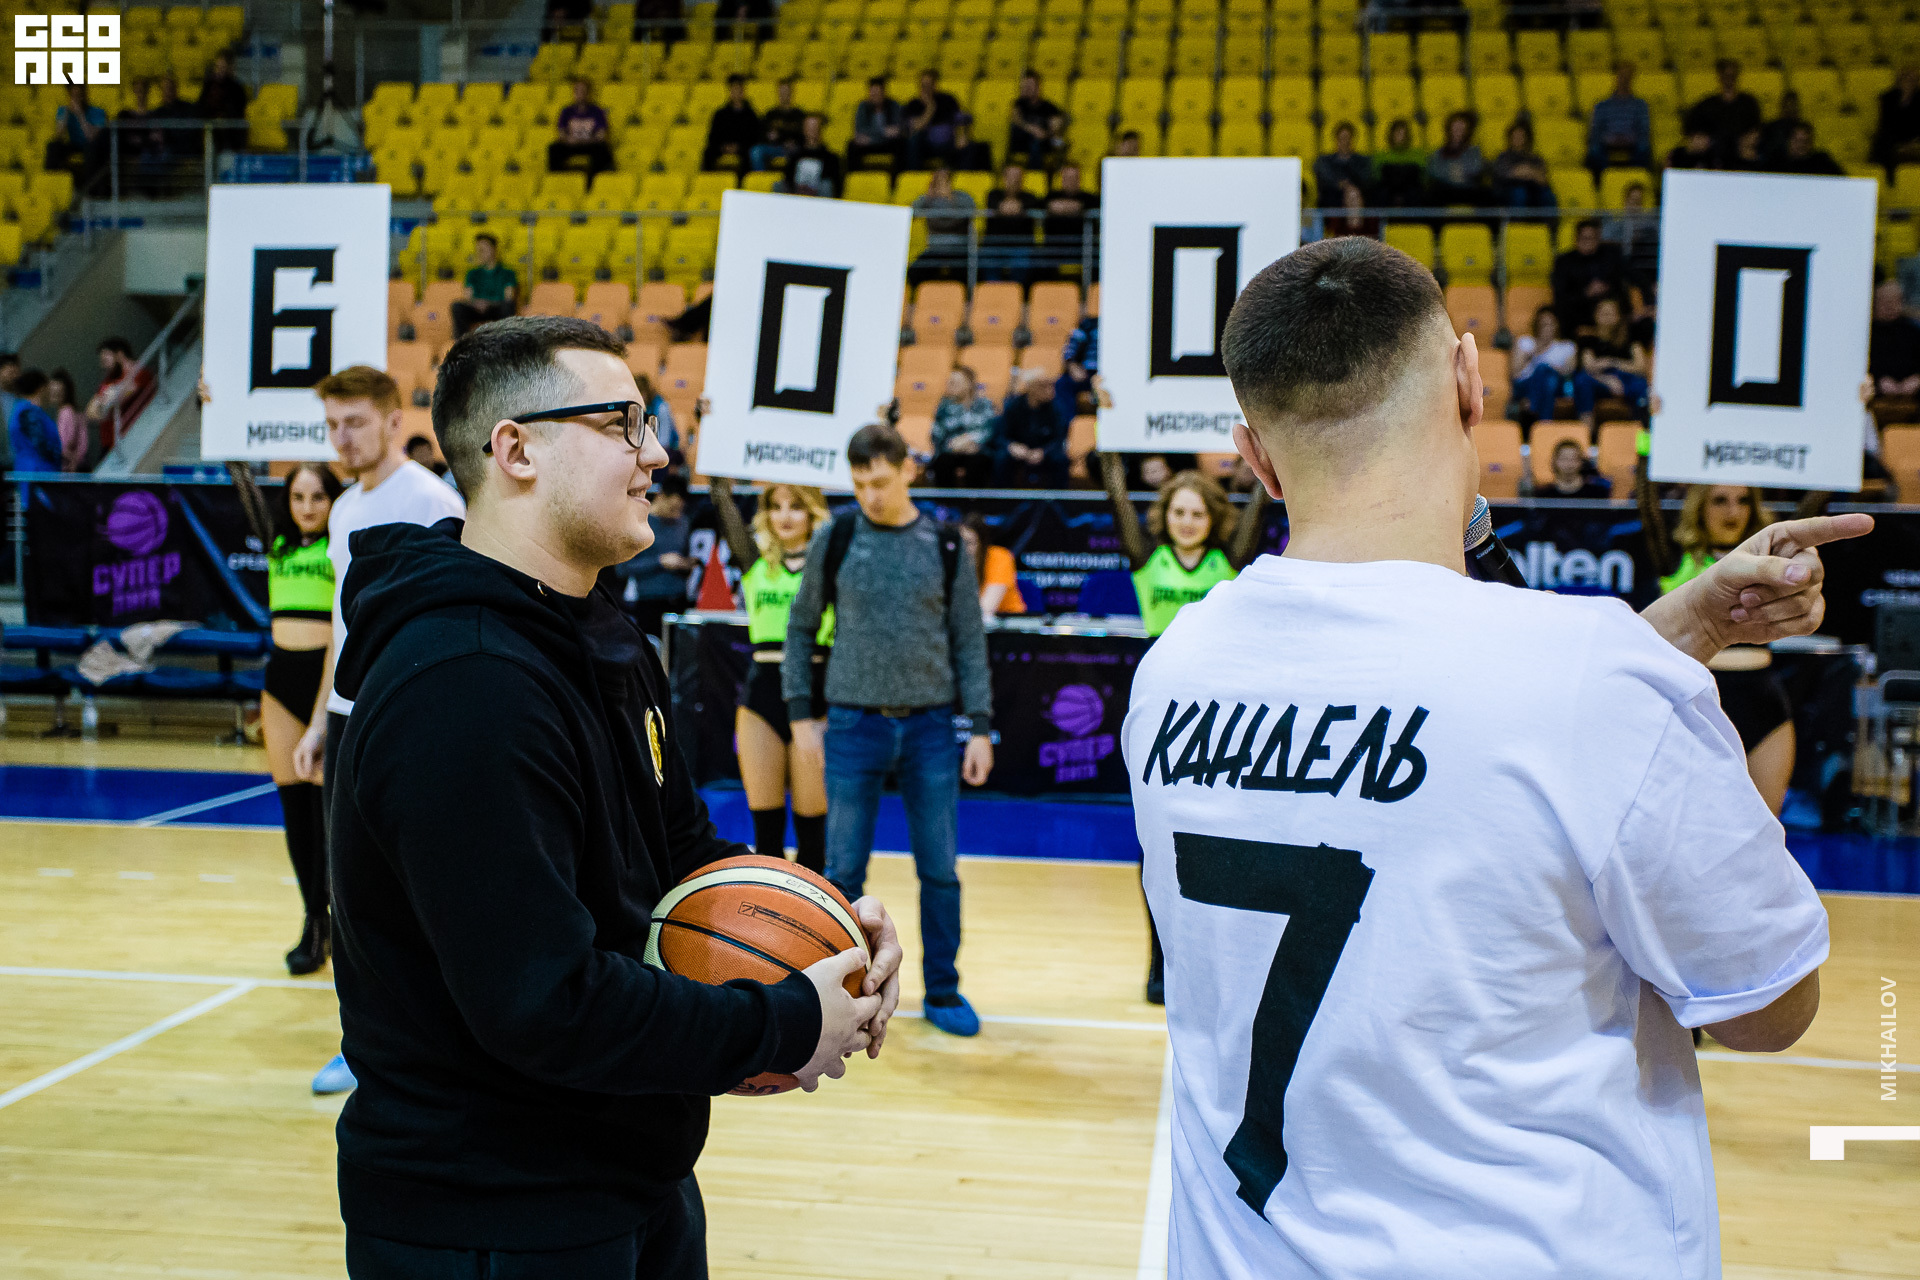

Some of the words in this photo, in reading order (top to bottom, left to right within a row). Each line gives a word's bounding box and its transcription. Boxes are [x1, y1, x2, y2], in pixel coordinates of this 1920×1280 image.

[250, 247, 336, 392] 6
[247, 421, 326, 448] MADSHO
[745, 441, 837, 472] MADSHOT
[1703, 441, 1810, 472] MADSHOT
[1143, 699, 1429, 803] КАНДЕЛЬ
[1173, 831, 1375, 1225] 7
